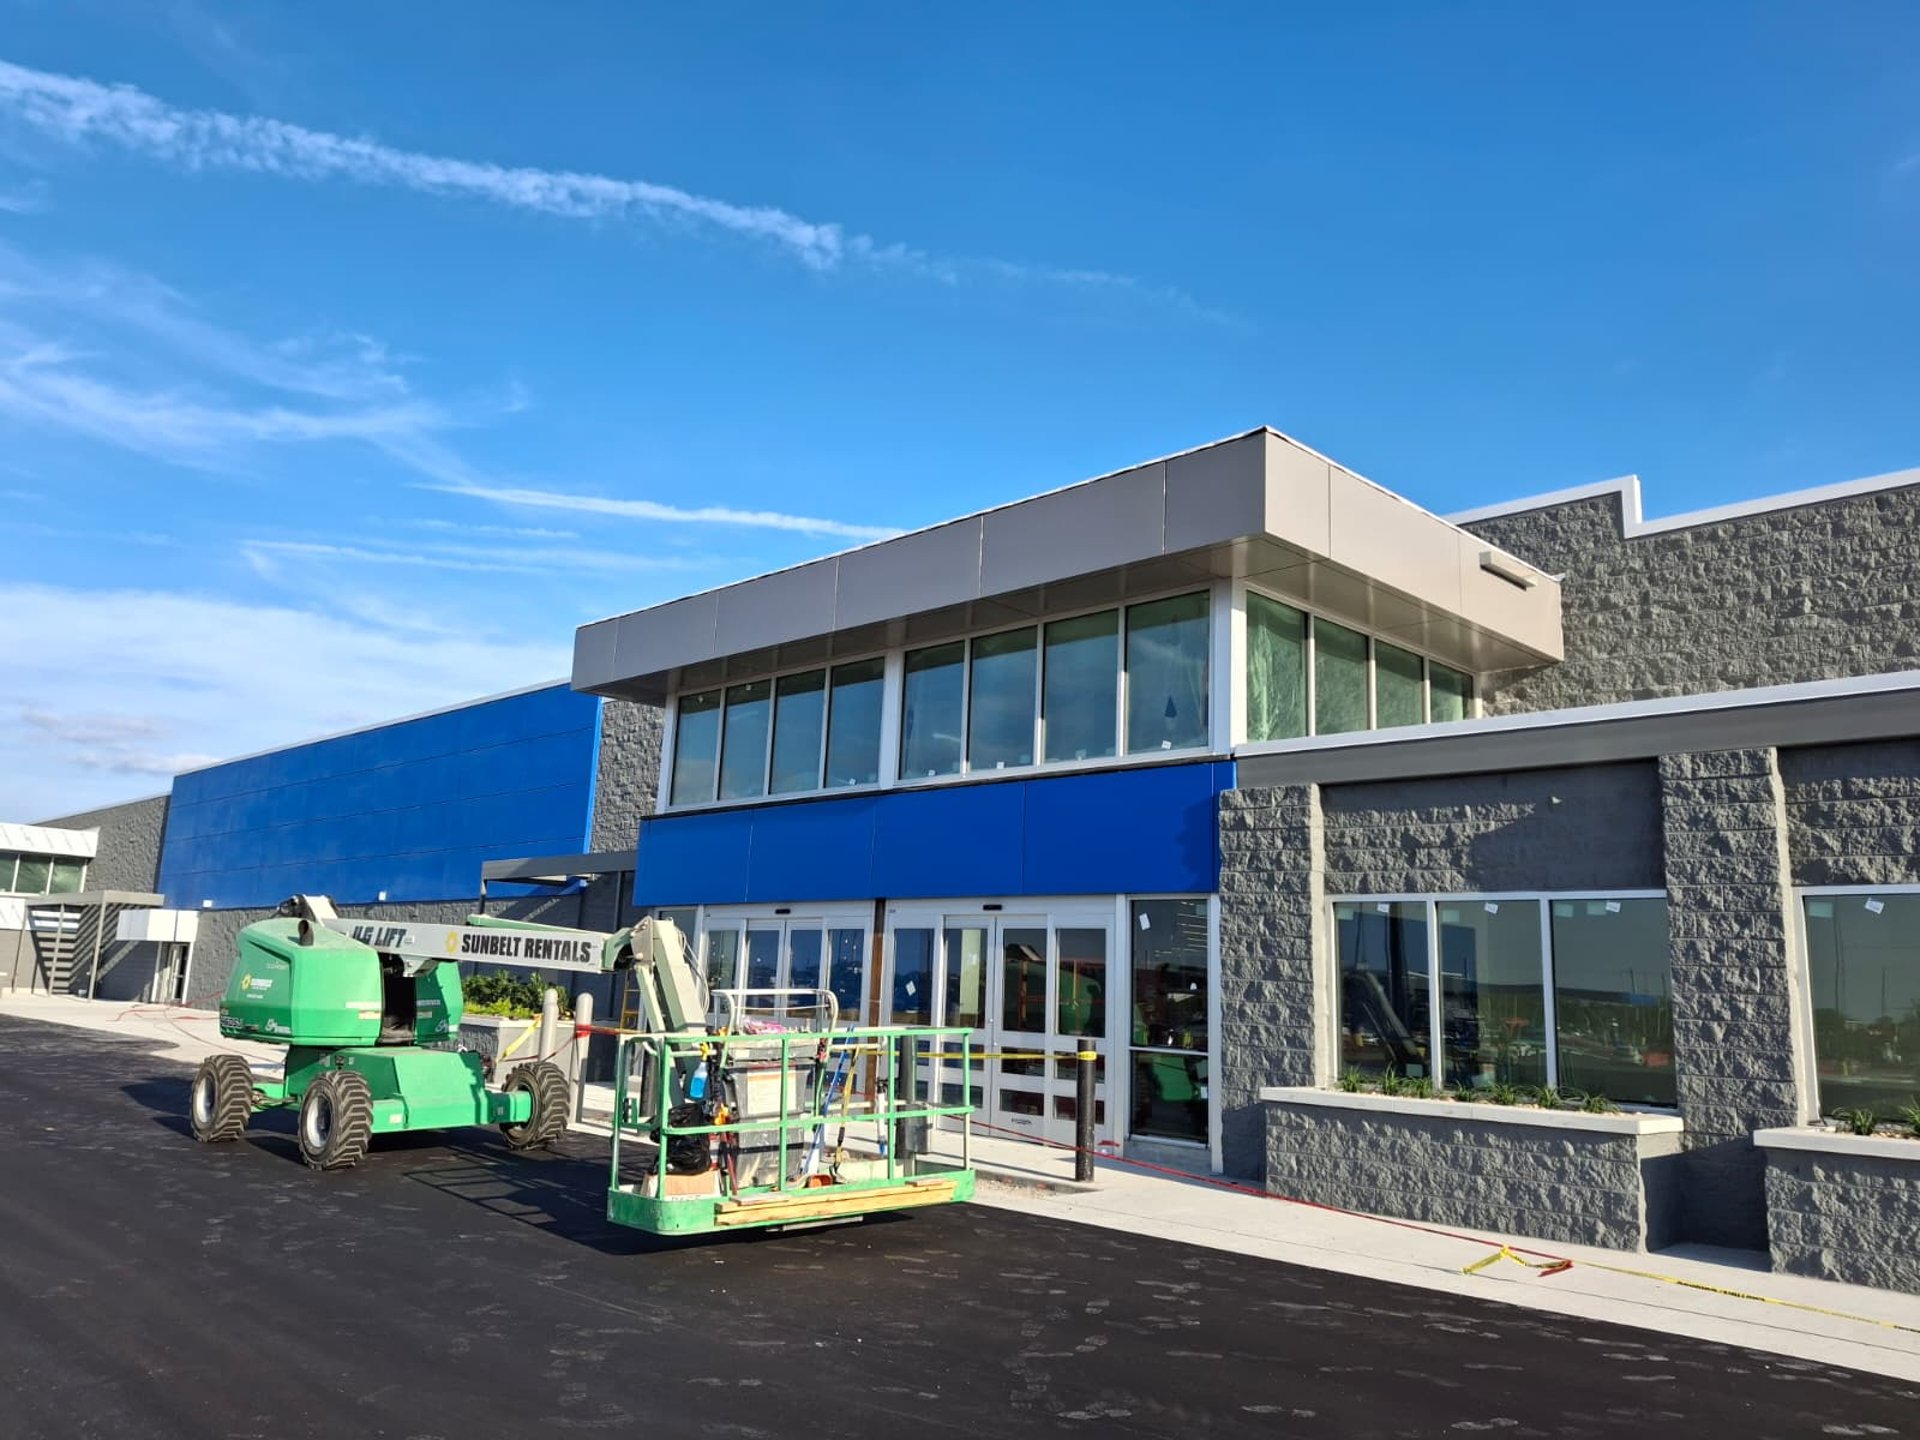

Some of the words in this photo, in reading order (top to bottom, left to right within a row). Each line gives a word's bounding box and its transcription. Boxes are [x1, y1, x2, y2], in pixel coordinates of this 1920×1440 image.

[374, 927, 407, 948] LIFT
[461, 933, 522, 958] SUNBELT
[523, 937, 592, 963] RENTALS
